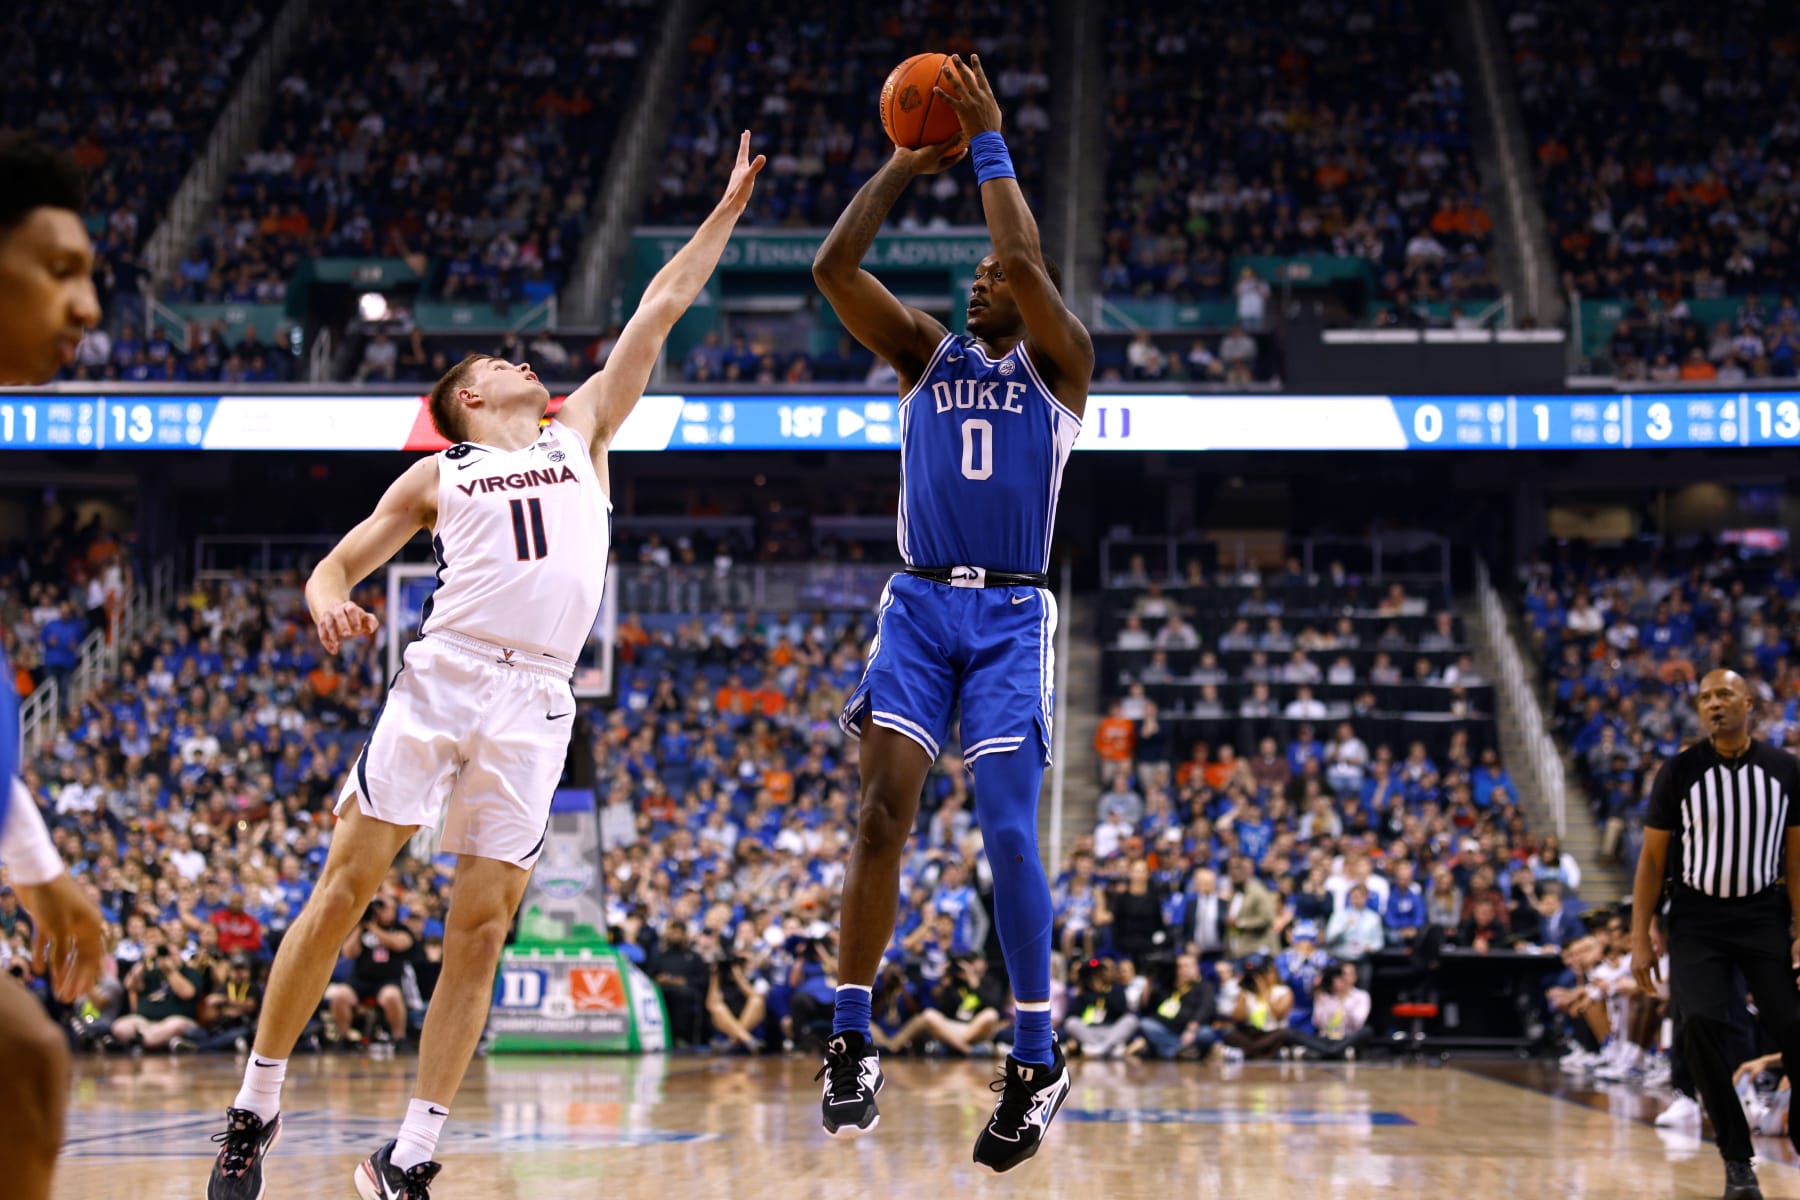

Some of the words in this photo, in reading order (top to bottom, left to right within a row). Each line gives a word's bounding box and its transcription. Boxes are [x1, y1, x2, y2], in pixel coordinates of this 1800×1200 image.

[932, 379, 1027, 414] DUKE
[111, 404, 154, 442] 13
[777, 404, 828, 438] 1ST
[1414, 404, 1443, 443] 0
[1532, 404, 1549, 442] 1
[1645, 402, 1673, 441] 3
[1754, 400, 1800, 439] 13
[961, 418, 993, 481] 0
[457, 465, 579, 497] VIRGINIA
[509, 497, 548, 562] 11
[502, 971, 542, 1006] D
